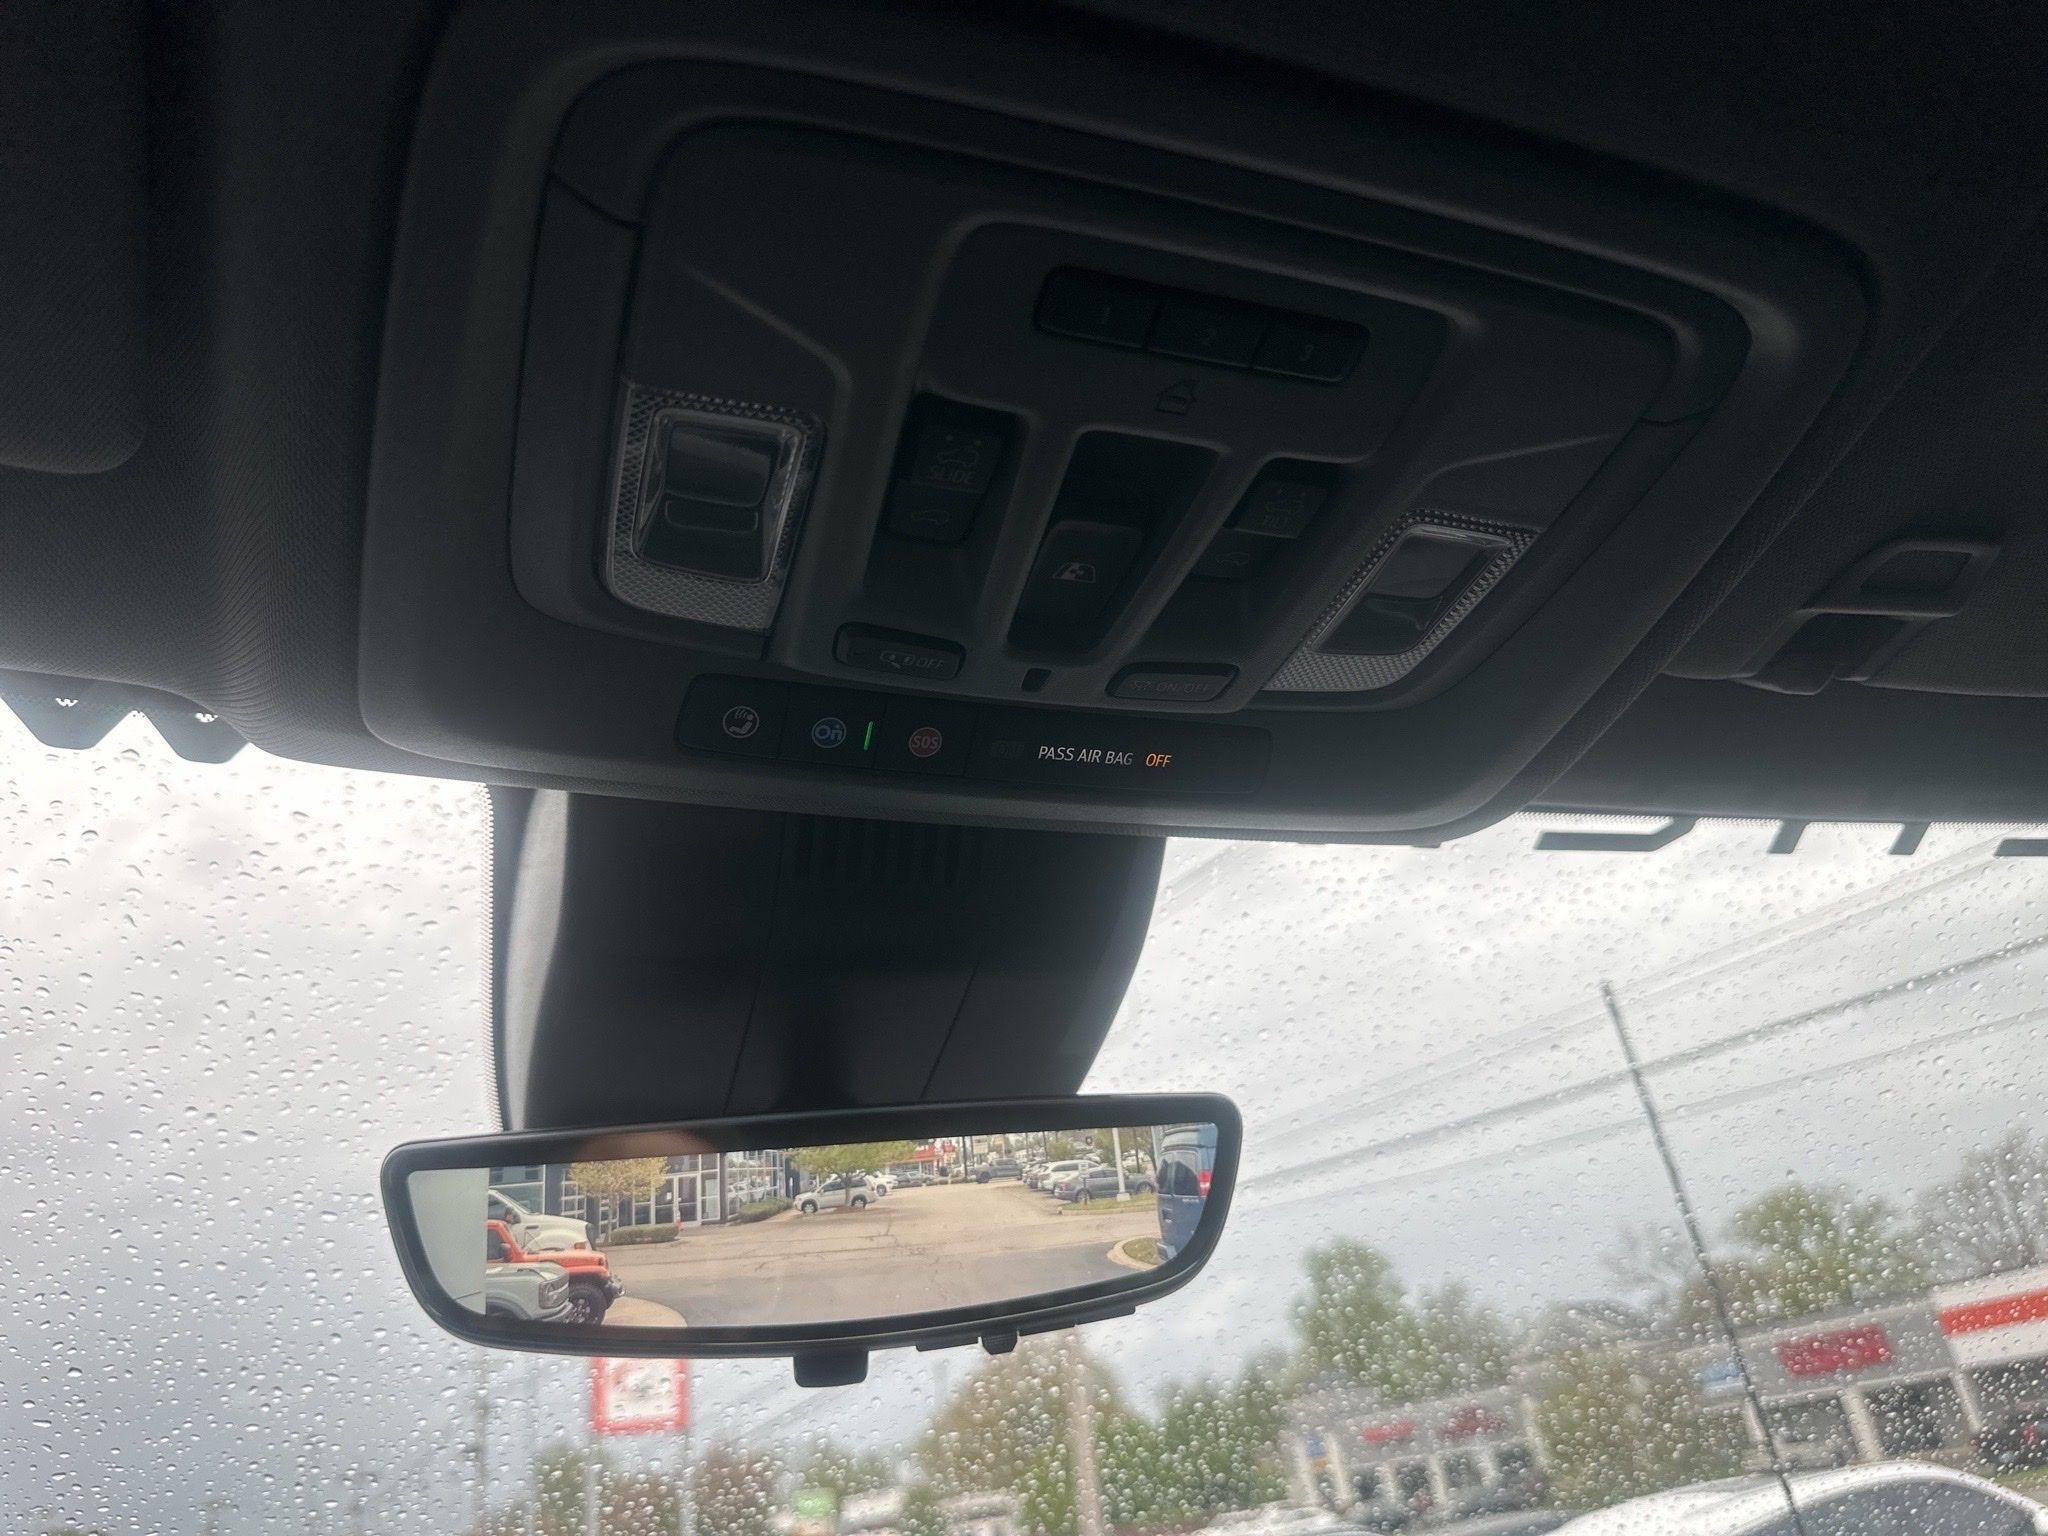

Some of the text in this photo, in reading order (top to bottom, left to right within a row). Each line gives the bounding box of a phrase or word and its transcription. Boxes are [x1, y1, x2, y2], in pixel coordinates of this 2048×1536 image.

[915, 656, 945, 670] OFF
[911, 735, 940, 749] SOS
[1037, 745, 1075, 762] PASS
[1076, 747, 1102, 764] AIR
[1104, 750, 1134, 766] BAG
[1144, 752, 1173, 768] OFF
